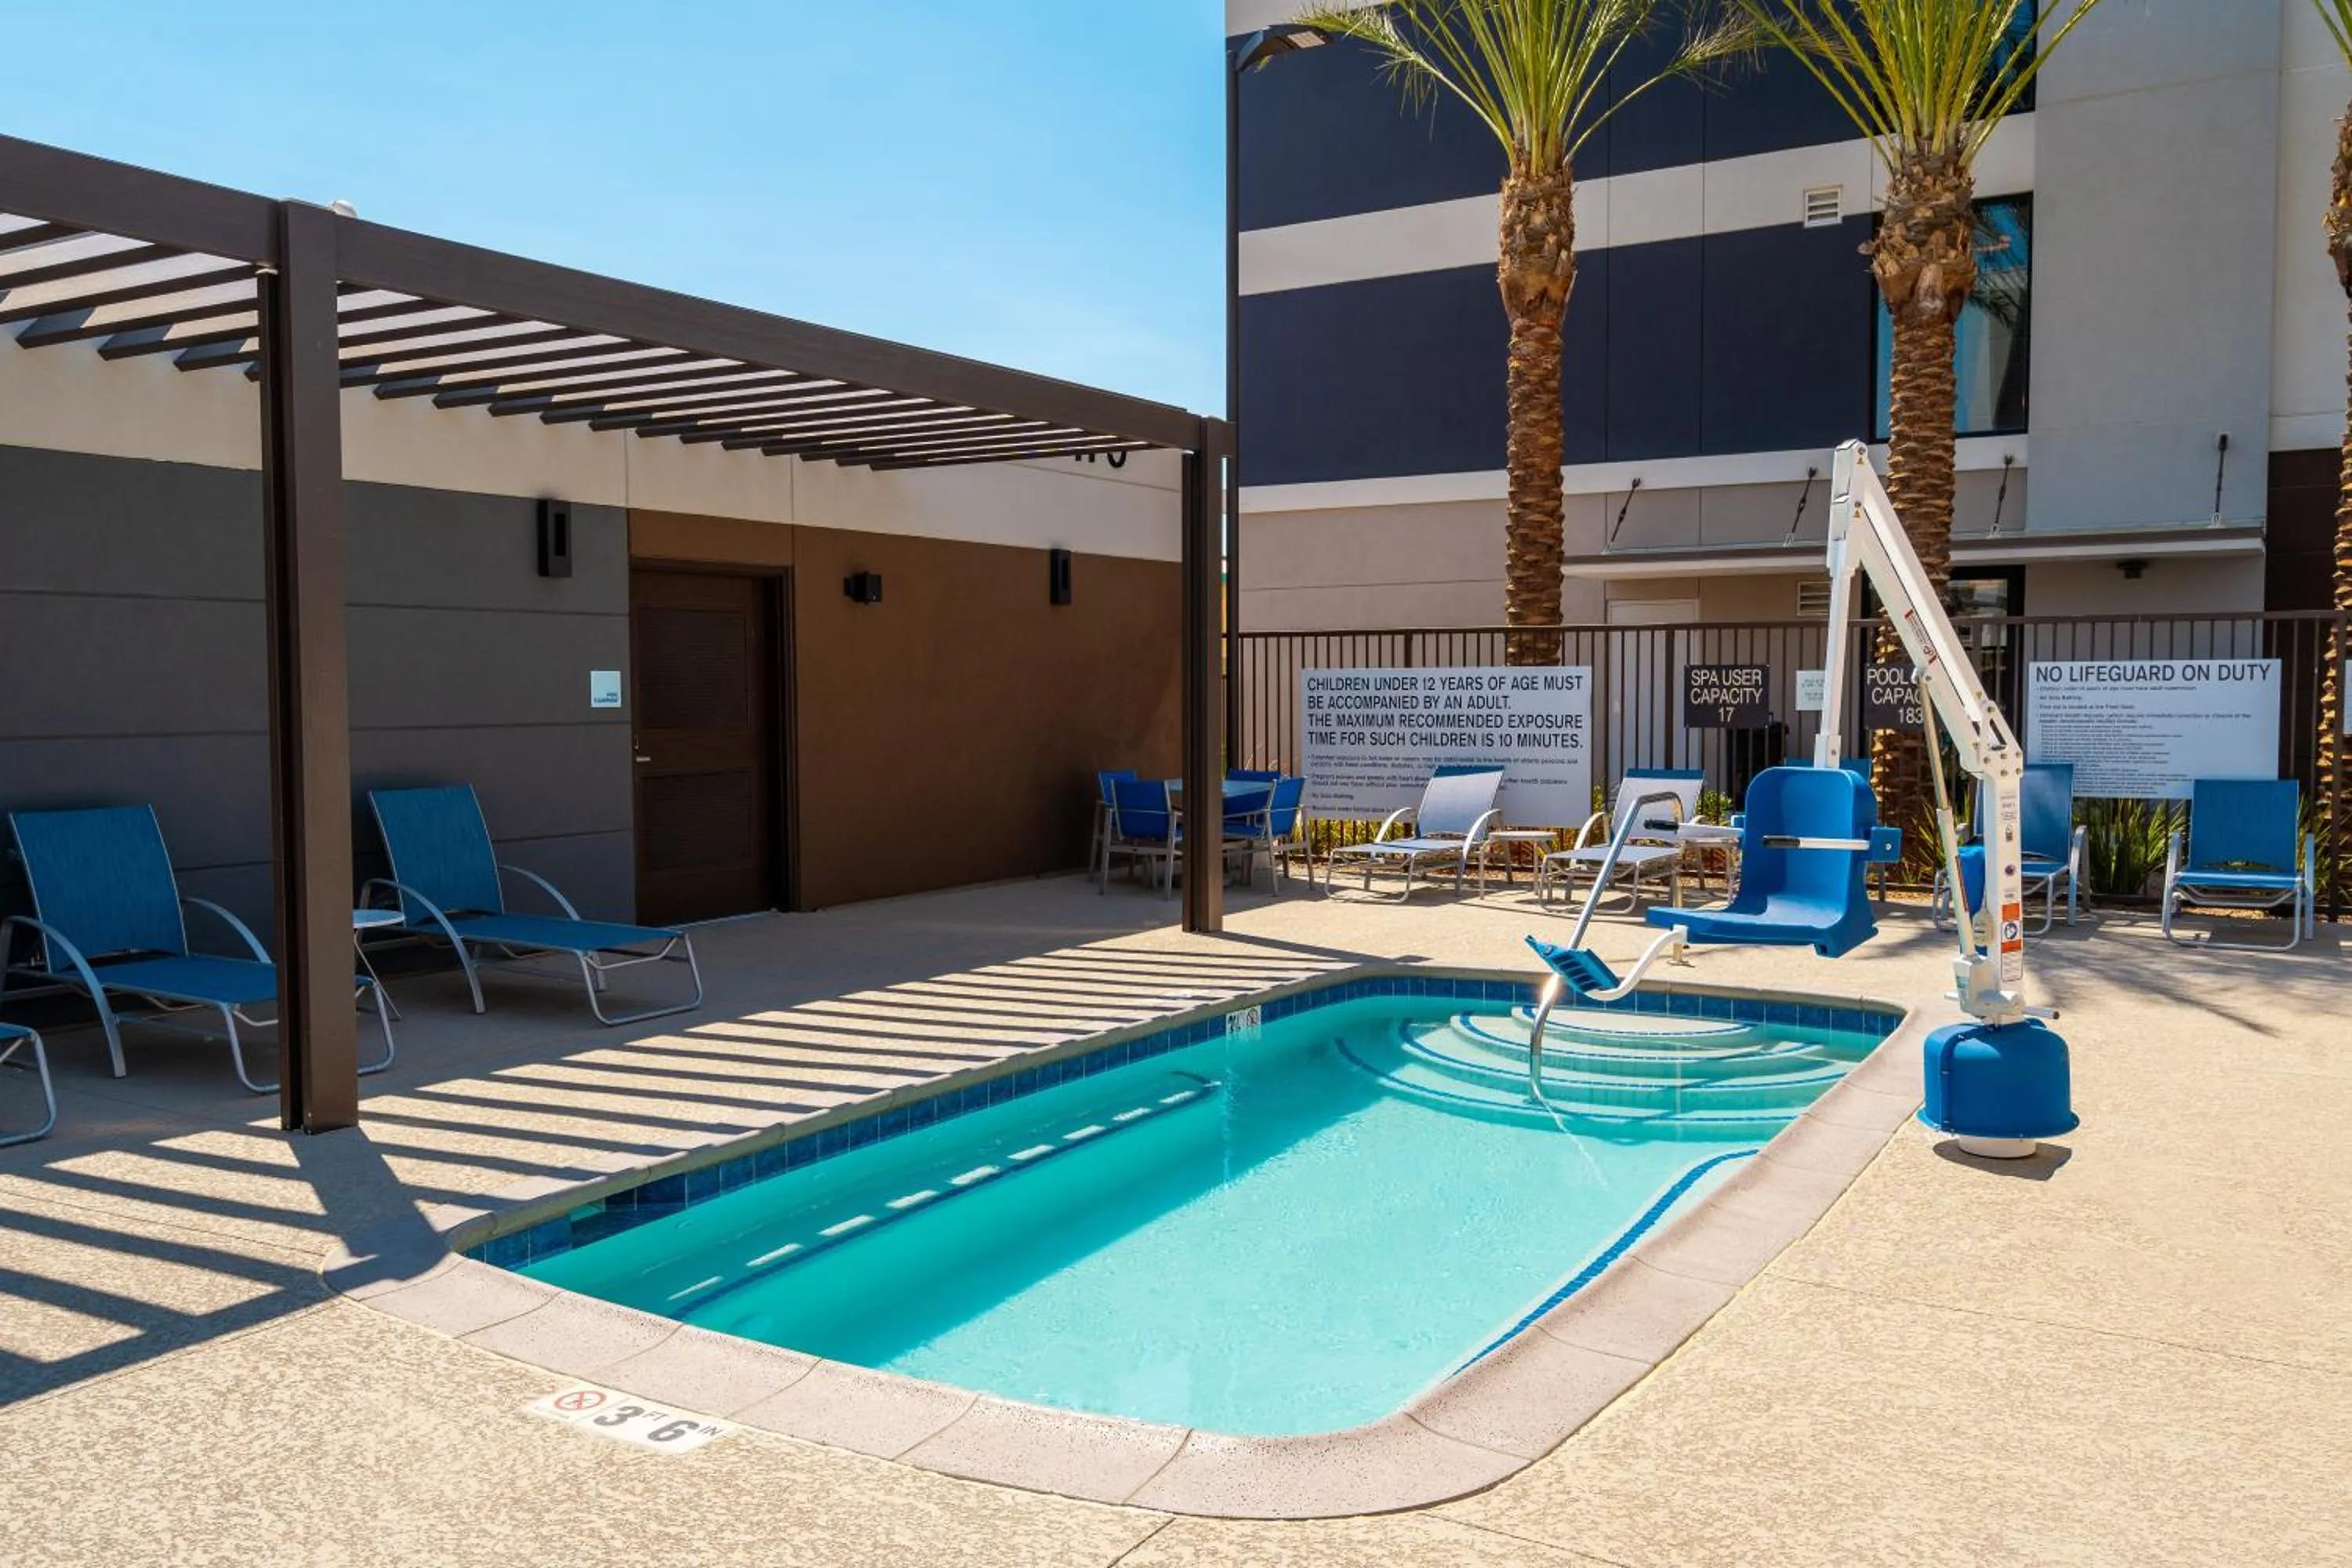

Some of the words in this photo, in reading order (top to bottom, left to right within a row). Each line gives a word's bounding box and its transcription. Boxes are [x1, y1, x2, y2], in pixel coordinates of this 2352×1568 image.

[1690, 671, 1719, 686] SPA
[1722, 669, 1762, 686] USER
[1867, 668, 1908, 685] POOL
[2035, 666, 2063, 682] NO
[2069, 665, 2175, 682] LIFEGUARD
[2182, 664, 2210, 681] ON
[2218, 663, 2271, 681] DUTY
[1307, 677, 1370, 691] CHILDREN
[1374, 677, 1418, 691] UNDER
[1423, 677, 1436, 691] 12
[1440, 677, 1483, 691] YEARS
[1489, 676, 1506, 691] OF
[1511, 676, 1539, 691] AGE
[1544, 675, 1583, 691] MUST
[1308, 696, 1323, 710] BE
[1328, 695, 1419, 710] ACCOMPANIED
[1424, 695, 1440, 709] BY
[1444, 695, 1462, 709] AN
[1468, 695, 1511, 710] ADULT.
[1690, 688, 1762, 704] CAPACITY
[1871, 688, 1921, 705] CAPAC
[1308, 714, 1333, 728] THE
[1337, 714, 1395, 728] MAXIMUM
[1399, 714, 1503, 728] RECOMMENDED
[1508, 714, 1583, 728] EXPOSURE
[1718, 708, 1733, 724] 17
[1898, 707, 1923, 724] 183
[1308, 732, 1336, 746] TIME
[1341, 731, 1365, 746] FOR
[1370, 731, 1406, 746] SUCH
[1410, 732, 1476, 747] CHILDREN
[1482, 732, 1494, 747] IS
[1499, 733, 1512, 747] 10
[1517, 733, 1584, 749] MINUTES.
[593, 1406, 645, 1426] 3
[642, 1411, 669, 1421] FT
[647, 1420, 699, 1442] 6
[699, 1426, 723, 1436] IN
